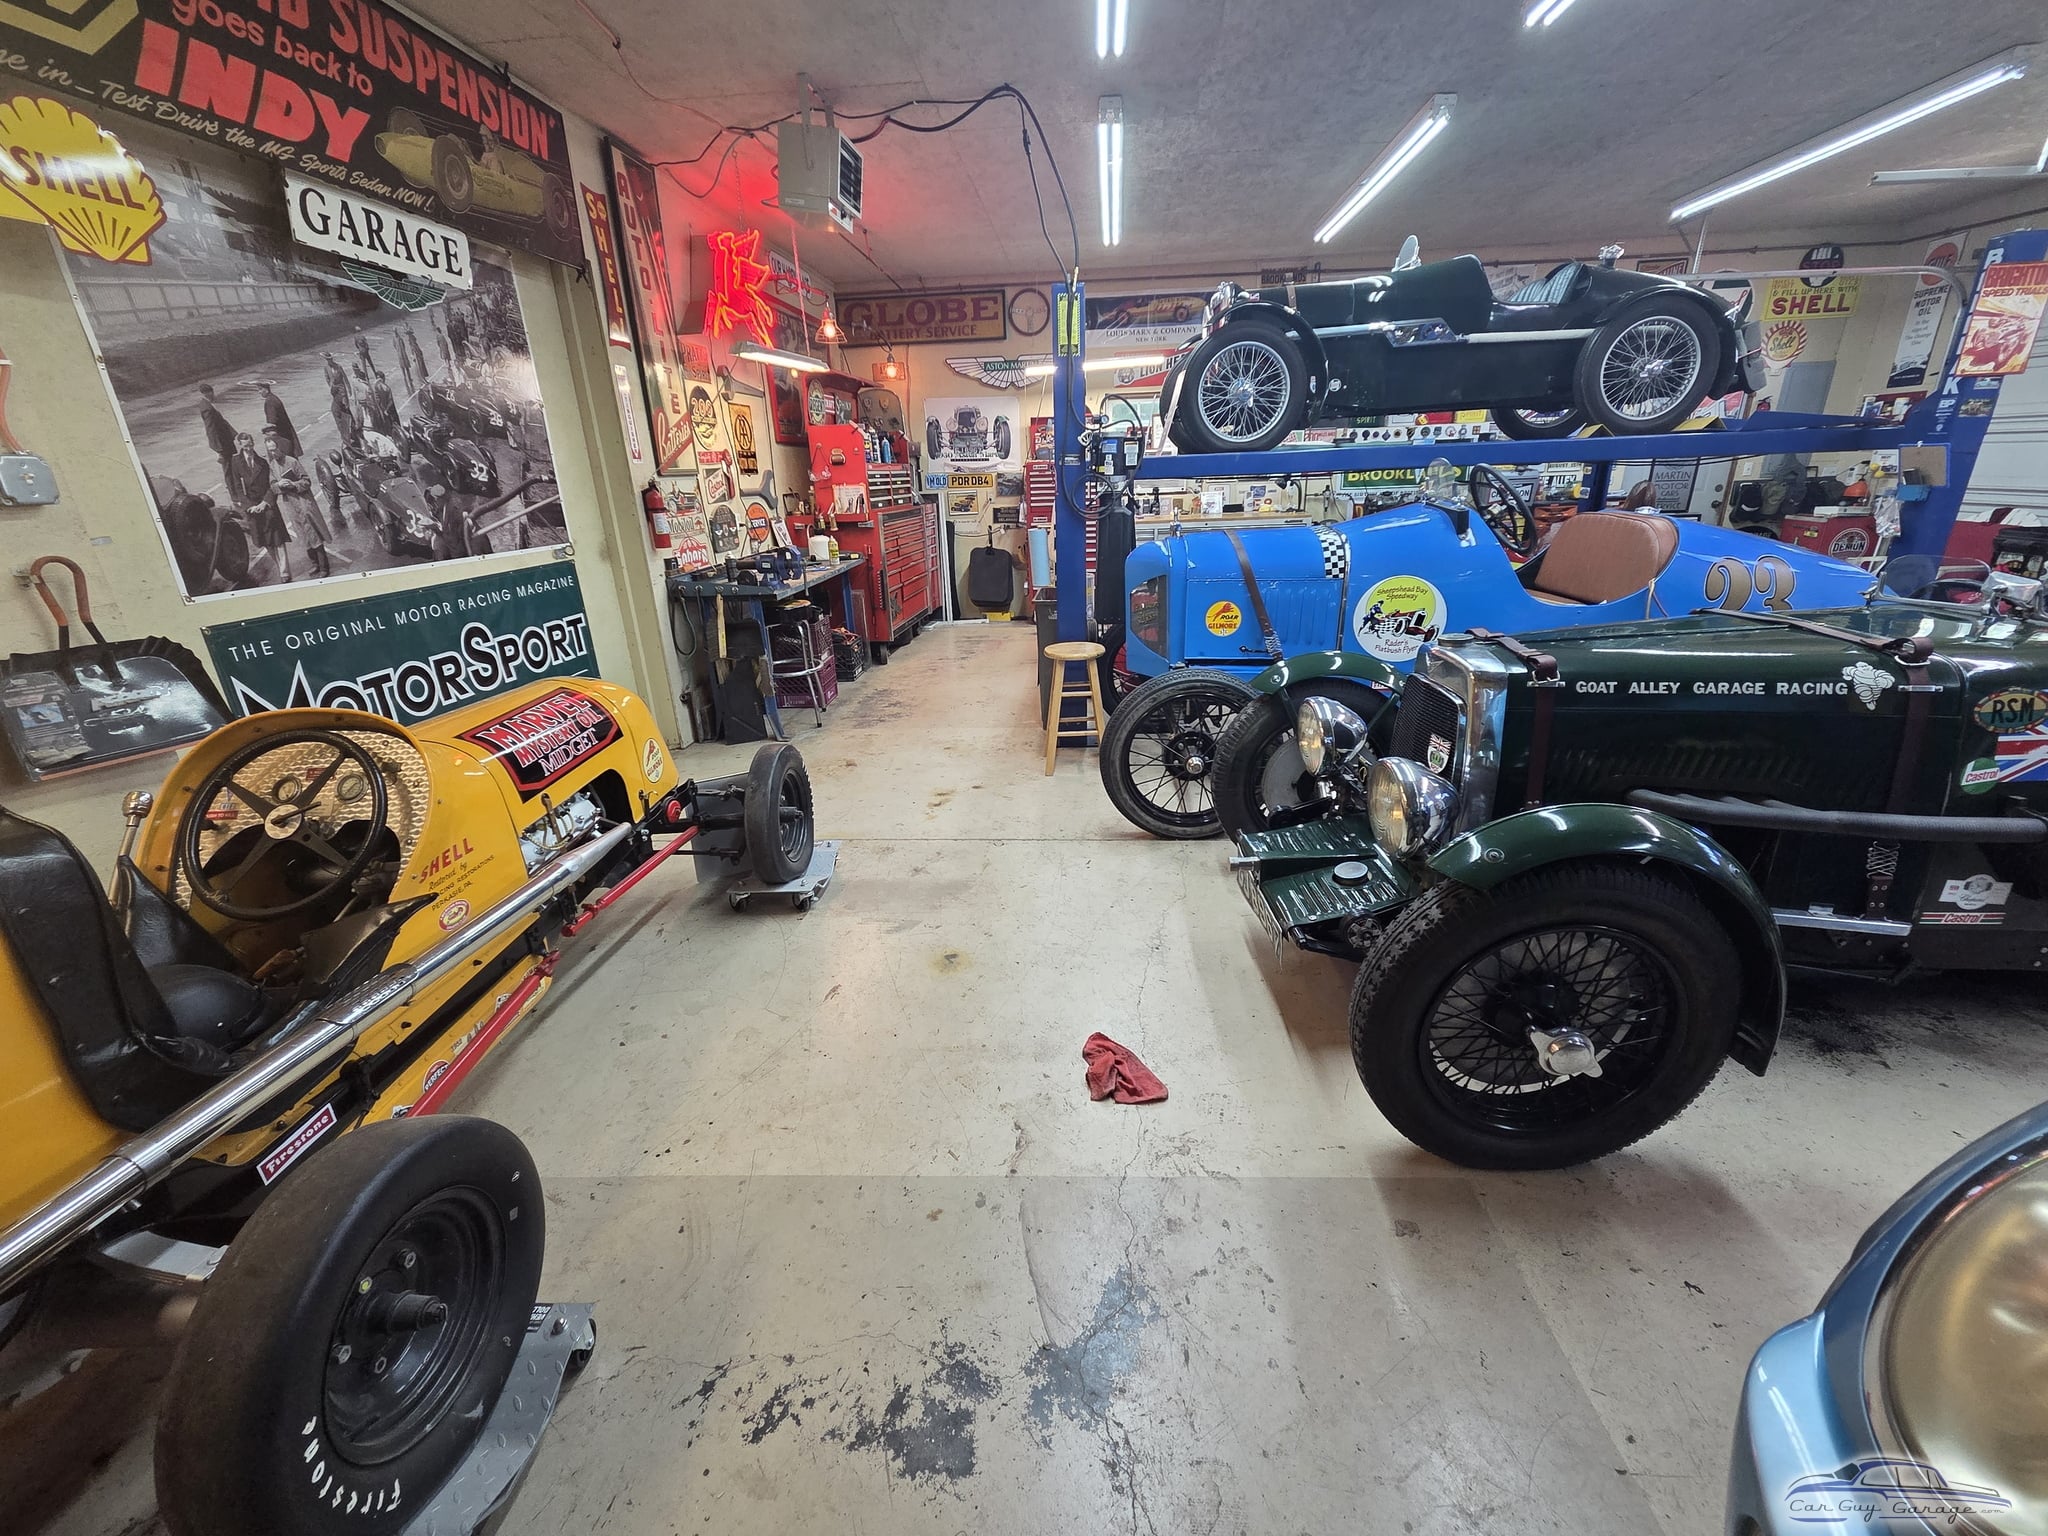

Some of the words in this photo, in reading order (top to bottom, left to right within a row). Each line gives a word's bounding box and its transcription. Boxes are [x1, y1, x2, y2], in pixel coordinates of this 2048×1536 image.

[172, 0, 265, 46] goes
[275, 25, 342, 83] back
[348, 63, 374, 96] to
[134, 18, 370, 163] INDY
[100, 79, 152, 112] Test
[154, 100, 219, 136] Drive
[225, 127, 256, 150] the
[259, 140, 295, 161] MG
[299, 153, 346, 180] Sports
[350, 171, 392, 197] Sedan
[8, 145, 145, 210] SHELL
[299, 187, 464, 277] GARAGE
[1781, 288, 1800, 296] FILL
[1813, 286, 1835, 294] HERE
[1913, 284, 1949, 299] SUPREME
[1981, 288, 2014, 297] SPEED
[2014, 286, 2048, 296] TRIALS
[1771, 294, 1851, 315] SHELL
[1914, 296, 1942, 308] MOTOR
[843, 296, 999, 327] GLOBE
[1918, 307, 1932, 316] OIL
[926, 324, 977, 337] SERVICE
[1161, 327, 1197, 335] COMPANY
[1770, 336, 1797, 352] Shell
[985, 362, 1010, 371] ASTON
[1356, 416, 1377, 424] SPIRIT
[1551, 475, 1576, 488] ALLEY
[1655, 471, 1692, 480] MARTIN
[1377, 585, 1415, 596] Sheepshead
[1415, 585, 1428, 595] Bay
[1704, 554, 1797, 612] 23
[1386, 593, 1418, 602] Speedway
[229, 640, 274, 663] THE
[285, 616, 386, 650] ORIGINAL
[395, 601, 453, 626] MOTOR
[458, 587, 512, 611] RACING
[516, 575, 575, 598] MAGAZINE
[1375, 645, 1402, 654] Flatbush
[1402, 645, 1419, 654] Flyer
[1575, 681, 1618, 694] GOAT
[1628, 682, 1681, 694] ALLEY
[1692, 682, 1766, 695] GARAGE
[1775, 682, 1849, 695] RACING
[1990, 697, 2036, 723] RSM
[476, 693, 592, 750] MARVEL
[513, 719, 582, 768] MYSTERY
[575, 707, 603, 728] OIL
[538, 728, 599, 777] MIDGET
[1965, 768, 2000, 783] Castrol
[419, 837, 474, 884] SHELL
[1943, 913, 1982, 924] Castrol
[424, 1064, 450, 1090] PERFECT
[264, 1114, 330, 1175] Firestone
